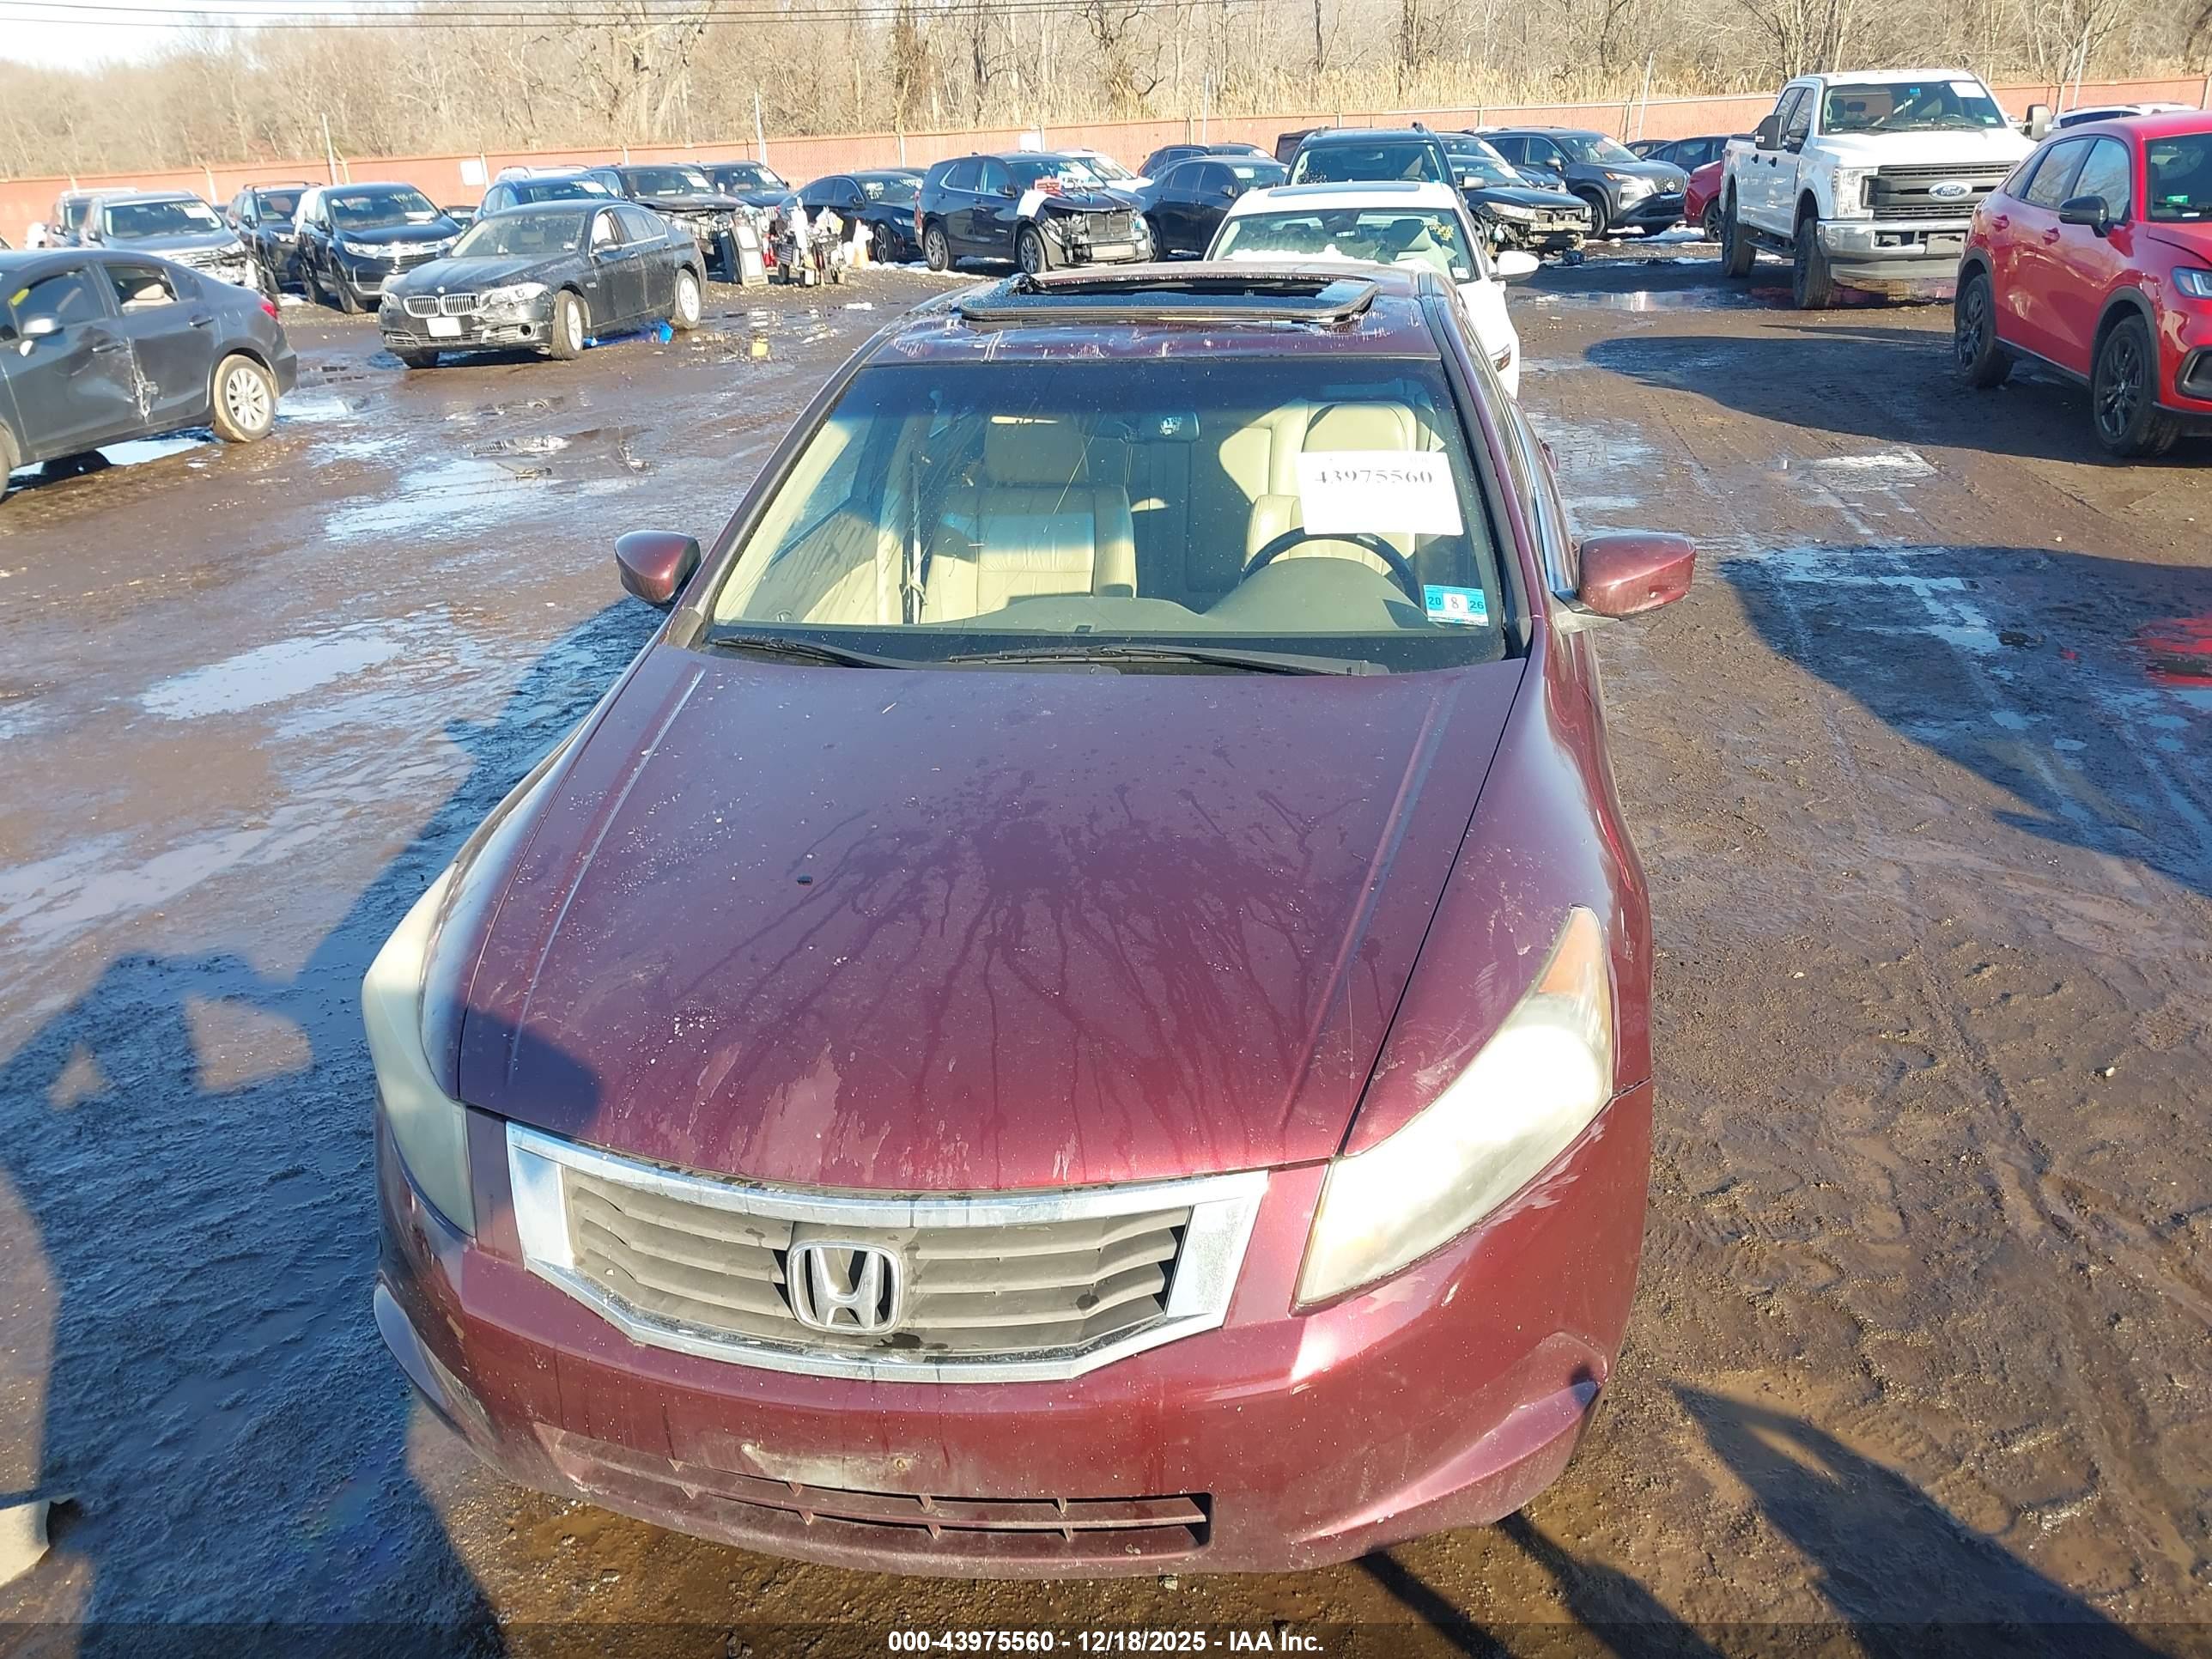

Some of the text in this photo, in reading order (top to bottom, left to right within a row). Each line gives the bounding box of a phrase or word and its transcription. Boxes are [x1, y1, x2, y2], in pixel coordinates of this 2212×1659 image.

[1316, 470, 1432, 483] 43975560
[1428, 596, 1485, 610] 20 8 26
